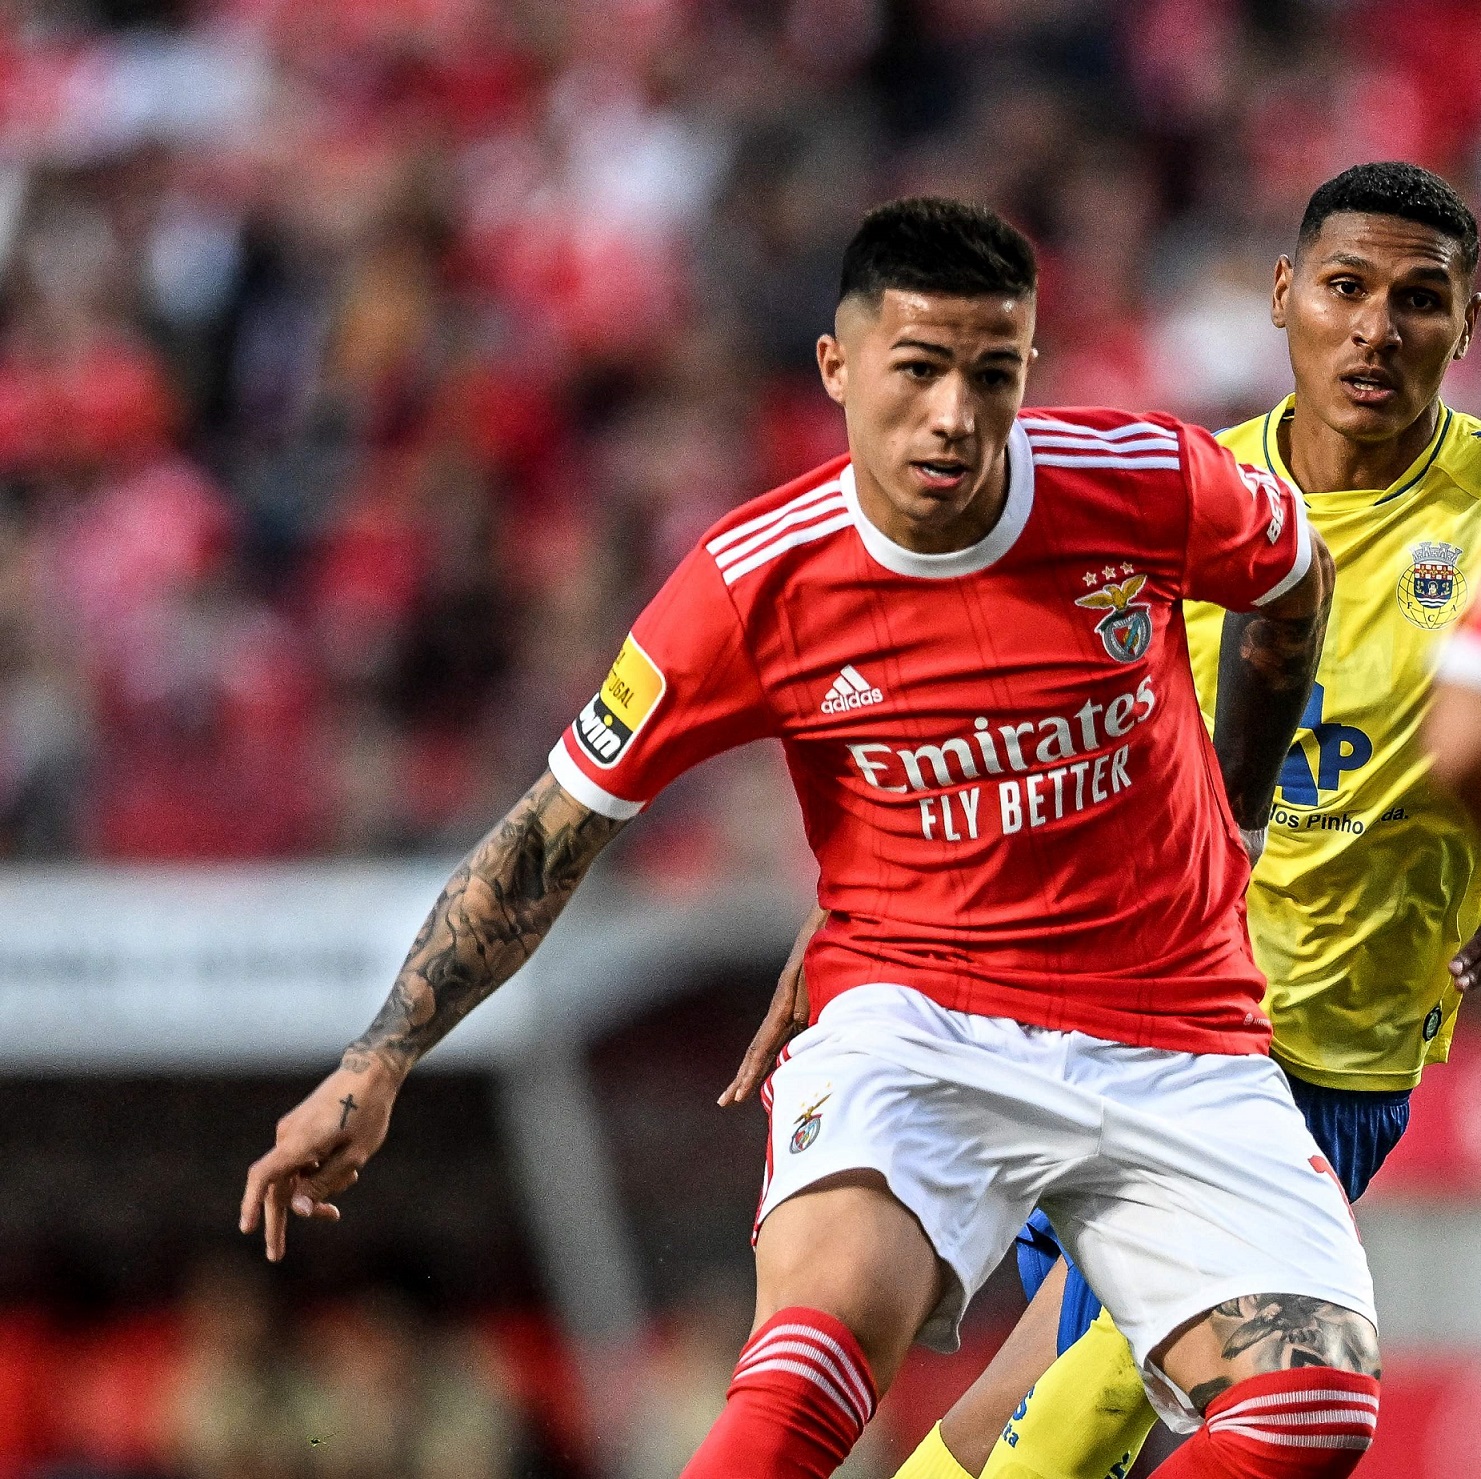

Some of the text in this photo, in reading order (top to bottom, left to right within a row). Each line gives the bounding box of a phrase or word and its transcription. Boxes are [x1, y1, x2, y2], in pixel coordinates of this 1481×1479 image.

[820, 687, 884, 715] adidas
[846, 675, 1157, 794] Emirates
[918, 744, 1132, 842] FLY BETTER
[1306, 814, 1364, 835] Pinho
